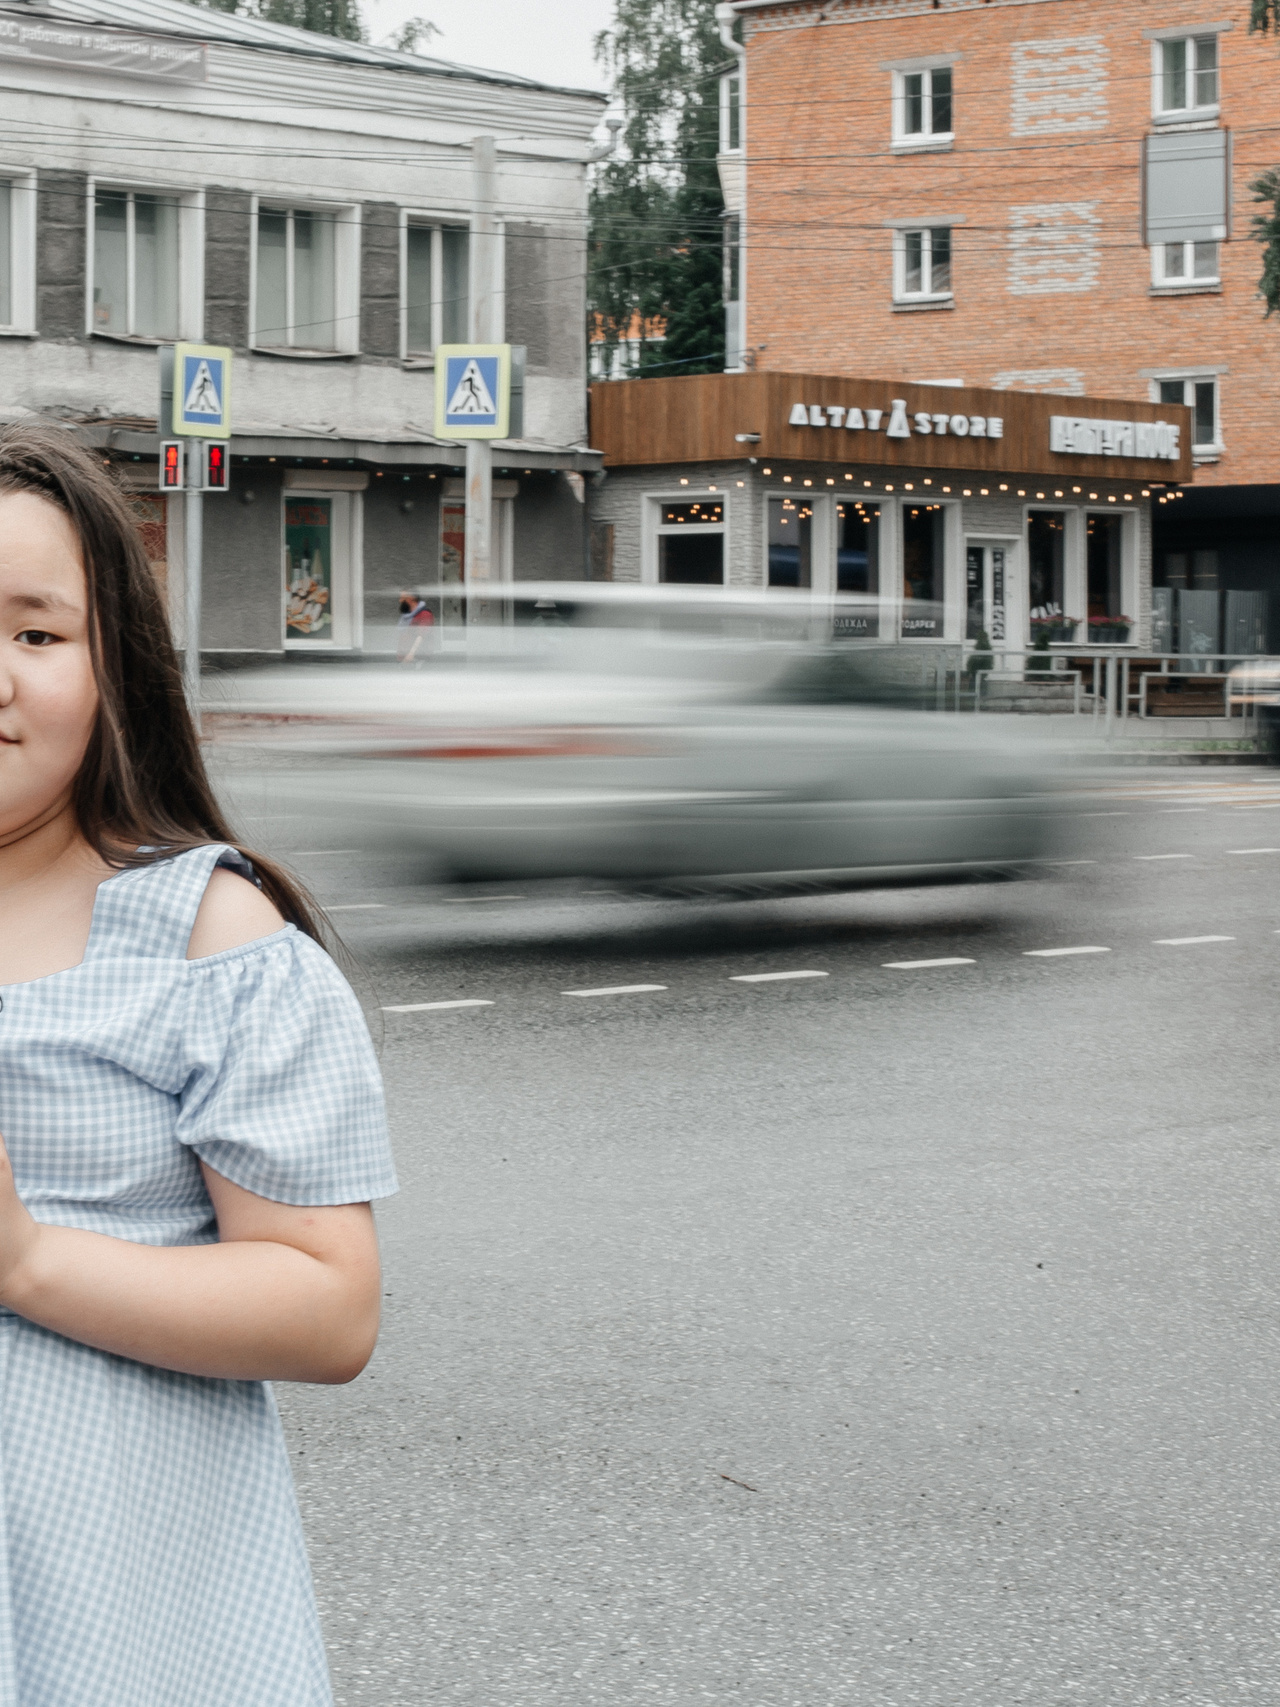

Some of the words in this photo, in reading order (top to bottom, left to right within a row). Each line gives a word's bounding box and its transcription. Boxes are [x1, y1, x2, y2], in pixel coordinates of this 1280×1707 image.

[19, 26, 80, 46] работают
[789, 403, 883, 430] ALTAY
[914, 412, 1004, 438] STORE
[834, 618, 867, 629] ОДЕЖДА
